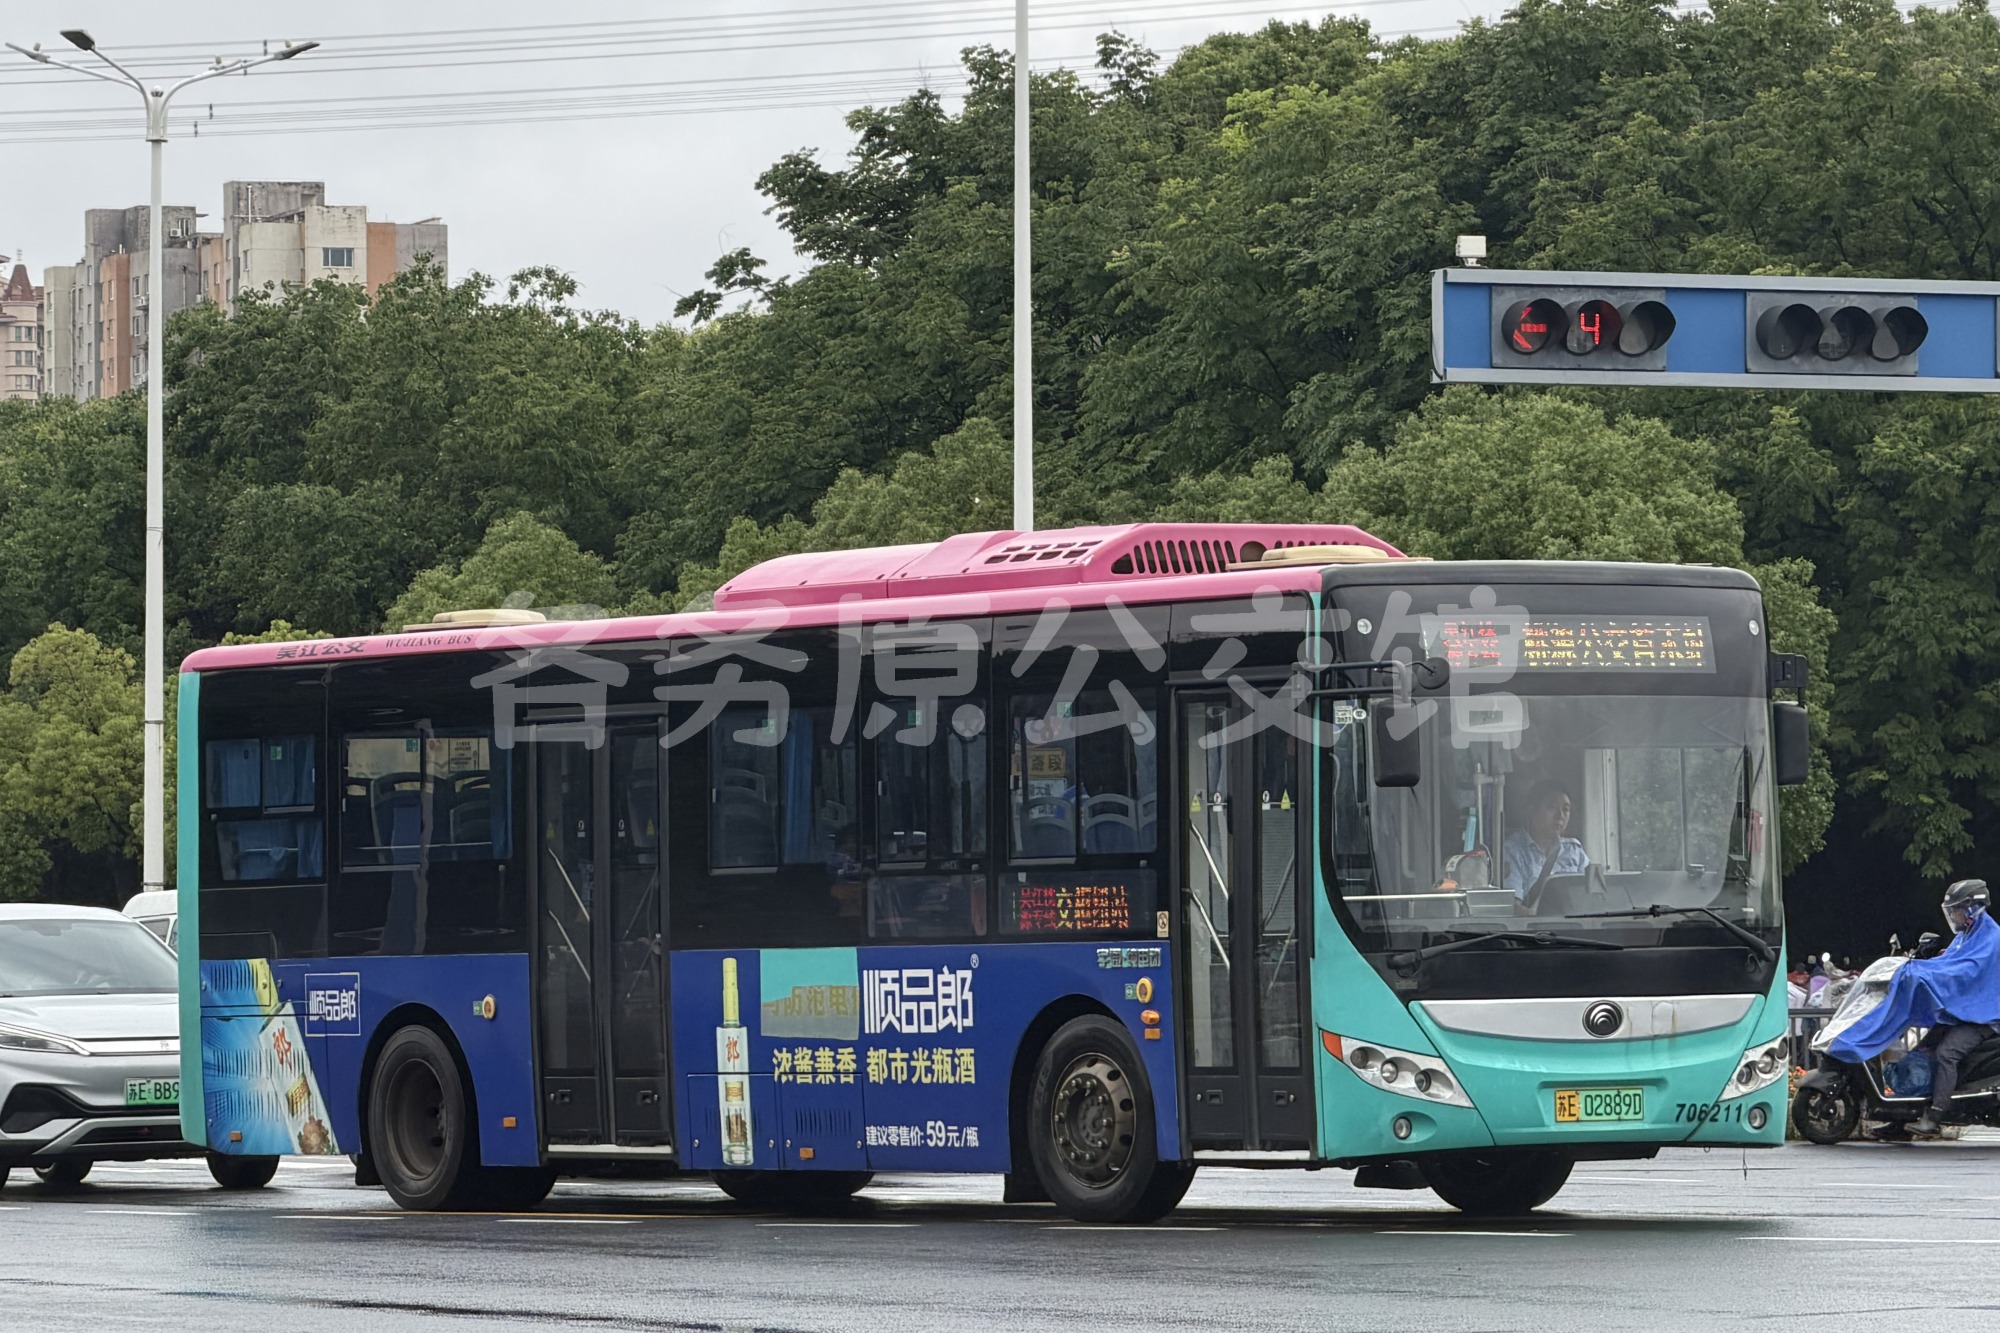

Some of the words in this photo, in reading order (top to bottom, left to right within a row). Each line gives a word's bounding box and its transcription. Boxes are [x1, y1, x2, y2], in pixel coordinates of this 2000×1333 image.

[1580, 312, 1600, 345] 4
[276, 639, 367, 659] 吴江公交
[385, 636, 443, 648] WUJIANG
[447, 634, 474, 645] BUS
[308, 989, 357, 1021] 顺品郎
[863, 964, 974, 1033] 顺品郎
[772, 1047, 857, 1084] 浓酱兼香
[866, 1047, 976, 1085] 都市光瓶酒
[1675, 1103, 1743, 1123] 706211
